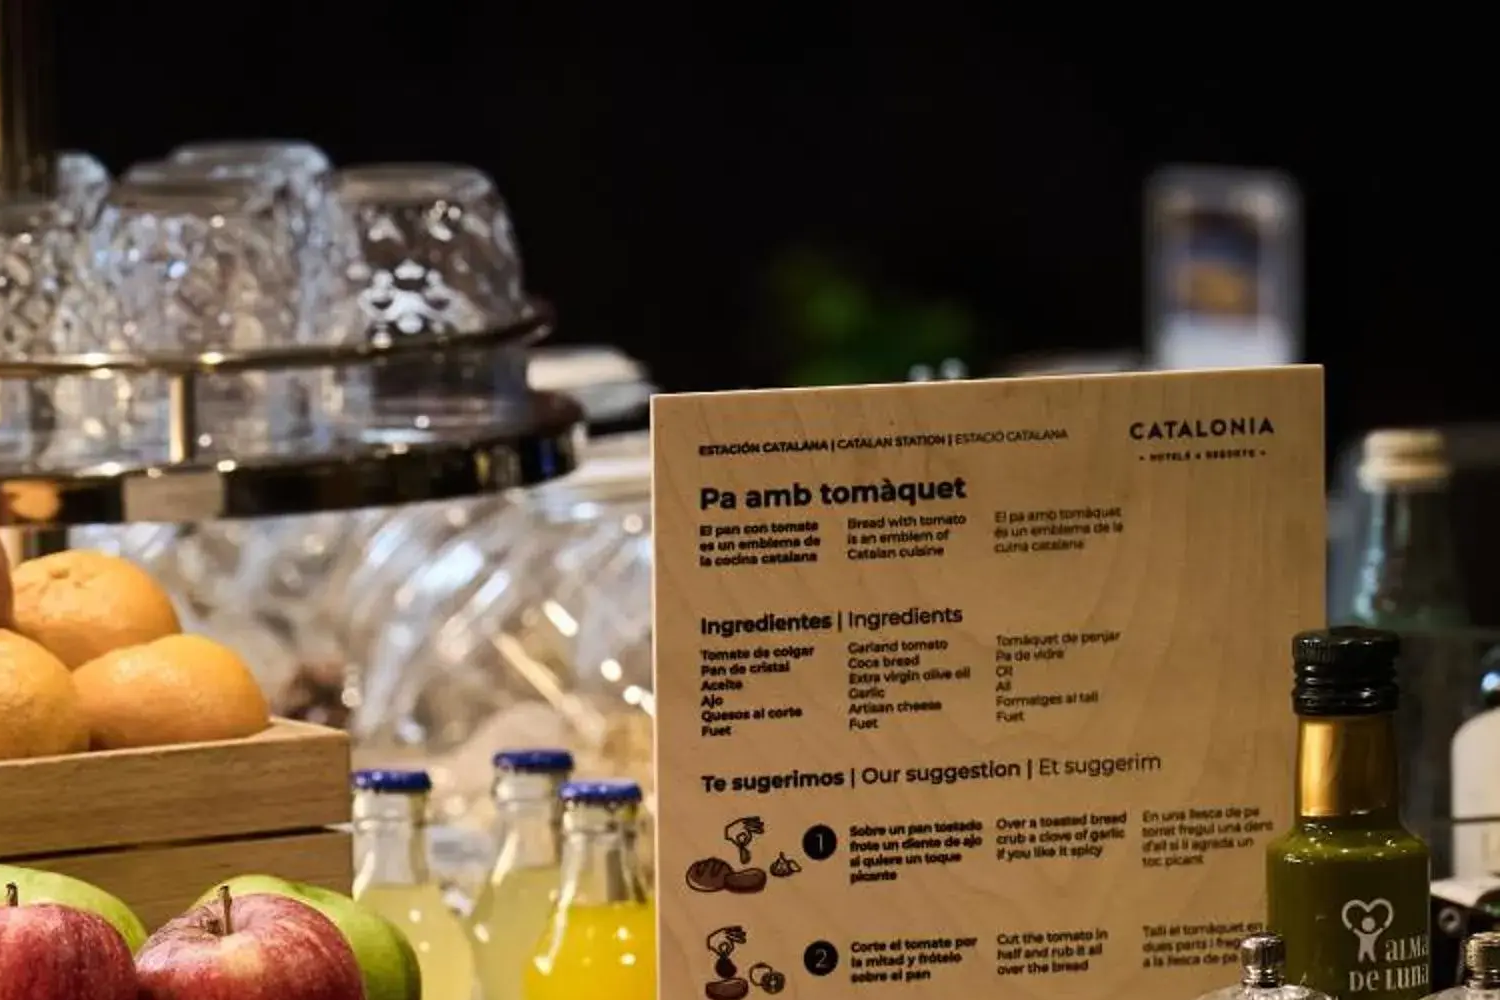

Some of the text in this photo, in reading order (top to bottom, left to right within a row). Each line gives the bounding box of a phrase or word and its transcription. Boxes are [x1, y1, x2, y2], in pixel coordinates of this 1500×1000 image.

[1129, 417, 1275, 441] CATALONIA
[700, 478, 967, 508] Pa amb tomàquet
[699, 521, 818, 538] El pan con tomate
[847, 515, 966, 529] Bread with tomato
[699, 535, 820, 552] es un emblema de
[847, 528, 949, 545] is an emblem of
[699, 551, 817, 567] la cocina catalana
[847, 545, 944, 559] Catalan cuisine
[701, 608, 962, 637] Ingredientes Ingredients
[901, 640, 948, 651] tomato
[700, 646, 814, 661] Tomate de colgar
[700, 660, 790, 676] Pan de cristal
[847, 654, 920, 669] Coca bread
[848, 666, 970, 684] Extra virgin olive oil
[700, 678, 743, 691] Aceite
[848, 686, 885, 699] Garlic
[700, 694, 723, 709] Ajo
[848, 701, 941, 714] Artisan cheese
[701, 707, 802, 721] Quesos al corte
[700, 755, 1160, 793] Te sugerimos Our suggestion Et suggerim
[850, 937, 977, 952] Corte el tomate por
[851, 956, 862, 968] la
[865, 954, 904, 967] mitad
[907, 955, 916, 968] y
[850, 969, 930, 983] sobre el pan
